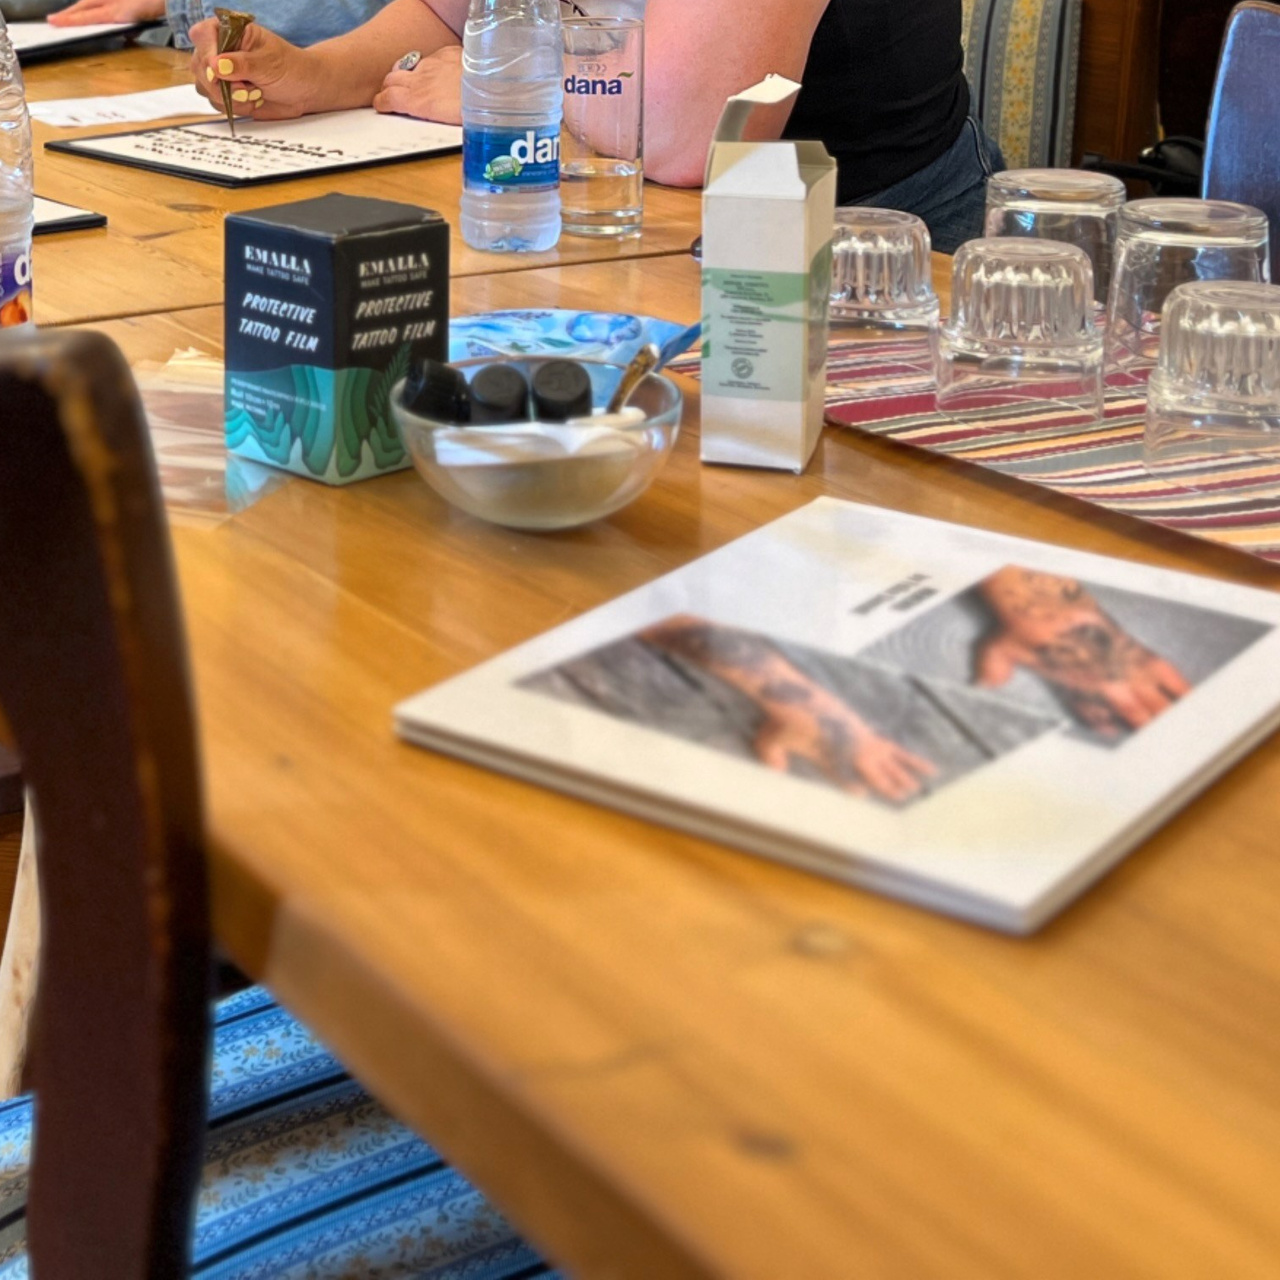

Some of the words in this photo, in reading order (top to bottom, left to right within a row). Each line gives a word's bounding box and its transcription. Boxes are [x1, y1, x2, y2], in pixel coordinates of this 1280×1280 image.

[564, 74, 622, 95] dana
[245, 245, 311, 274] EMALLA
[359, 252, 429, 278] EMALLA
[242, 292, 317, 324] PROTECTIVE
[355, 290, 433, 319] PROTECTIVE
[239, 318, 280, 342] TATTOO
[285, 330, 319, 352] FILM
[351, 327, 398, 350] TATTOO
[402, 320, 436, 341] FILM
